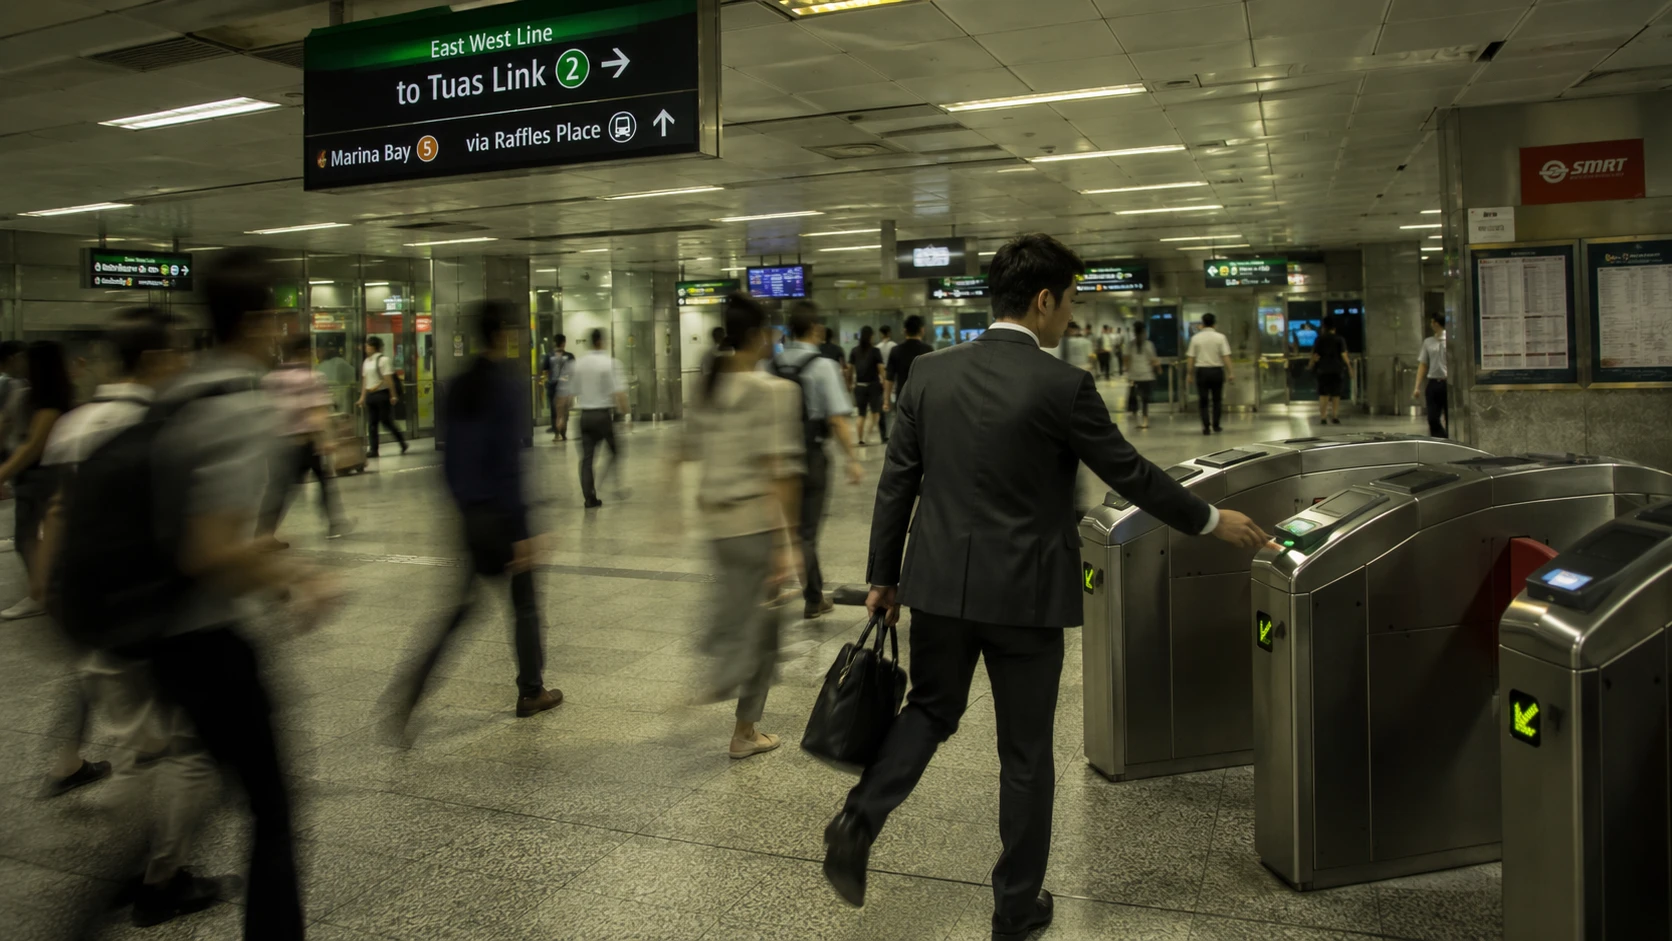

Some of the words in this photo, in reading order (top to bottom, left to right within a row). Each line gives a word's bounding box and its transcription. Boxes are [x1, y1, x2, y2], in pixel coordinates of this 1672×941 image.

[431, 38, 465, 58] East
[470, 31, 512, 53] West
[517, 25, 553, 46] Line
[396, 80, 420, 105] to
[427, 73, 484, 100] Tuas
[493, 58, 547, 93] Link
[566, 57, 579, 81] 2
[466, 132, 489, 152] via
[495, 127, 551, 150] Raffles
[556, 122, 601, 143] Place
[331, 148, 380, 167] Marina
[384, 143, 412, 164] Bay
[423, 140, 433, 157] 5
[1570, 157, 1628, 174] SMRT
